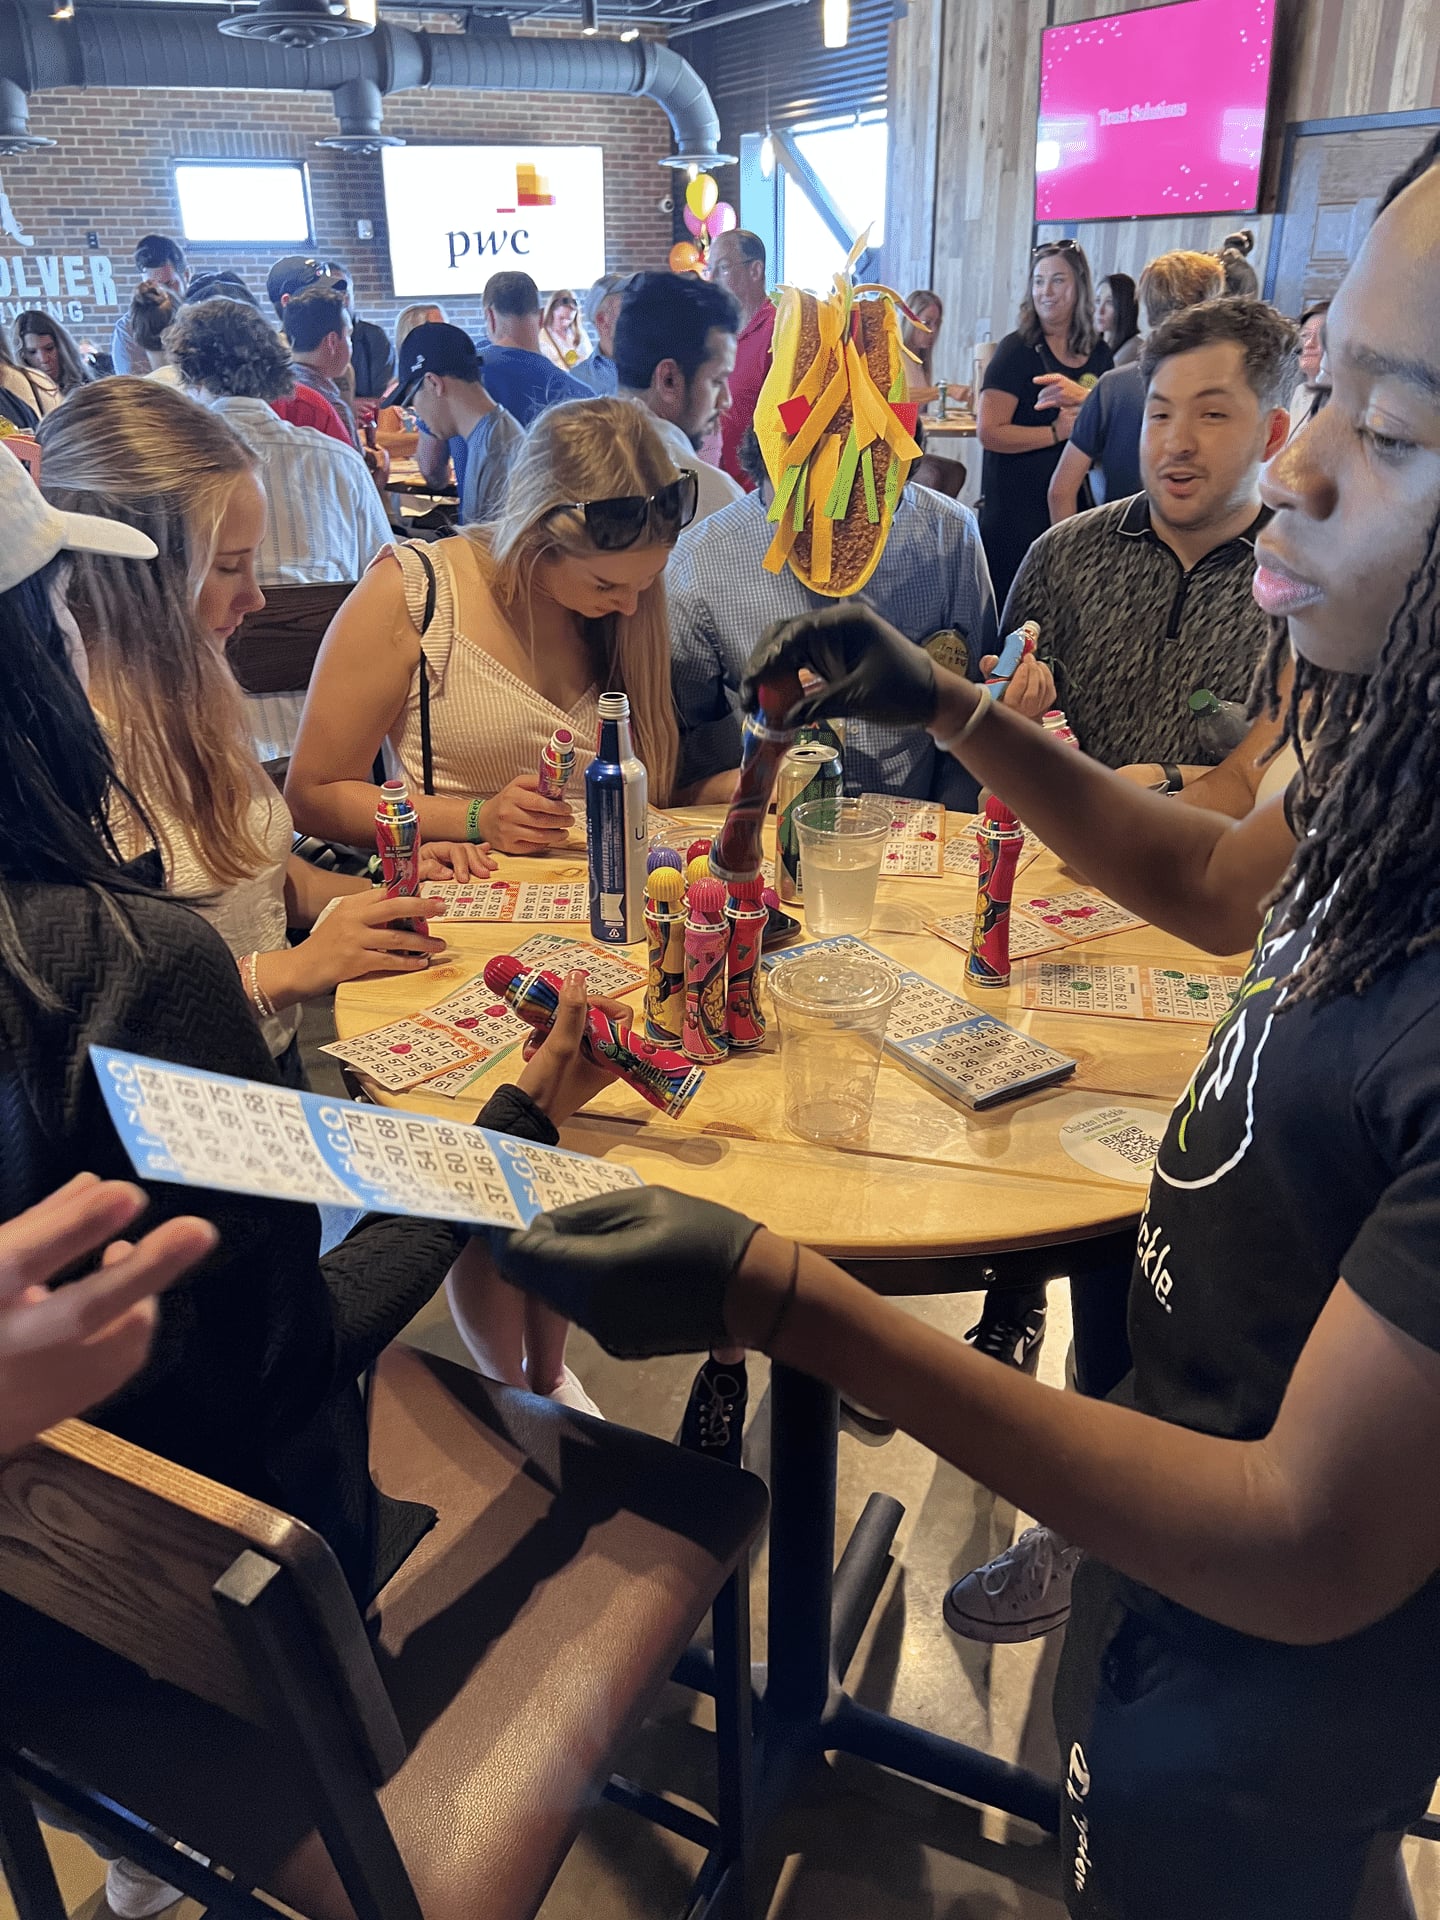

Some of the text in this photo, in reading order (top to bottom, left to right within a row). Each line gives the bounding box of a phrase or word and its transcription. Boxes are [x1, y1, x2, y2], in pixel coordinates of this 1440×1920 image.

[1130, 100, 1187, 123] Solutions
[444, 229, 530, 269] pwc
[586, 976, 616, 991] 59 71
[614, 978, 629, 986] 61
[910, 982, 926, 990] 67
[1059, 972, 1071, 980] 52
[475, 988, 487, 996] 15
[905, 989, 939, 1002] 59 68
[918, 996, 951, 1009] 49 64
[1041, 997, 1053, 1005] 12
[1060, 990, 1072, 998] 23
[1096, 992, 1108, 1000] 30
[1158, 997, 1170, 1006] 24
[1207, 975, 1227, 1011] 27 74
[1078, 1000, 1090, 1008] 13
[1176, 999, 1188, 1008] 17
[1195, 1001, 1208, 1009] 22
[432, 1007, 503, 1045] 13 19 56 65
[459, 1007, 475, 1016] 30
[487, 1021, 503, 1031] 46
[501, 1028, 518, 1039] 72
[475, 1001, 490, 1009] 17
[501, 1014, 518, 1024] 50
[515, 1021, 532, 1031] 61
[896, 1003, 963, 1027] 16 33 47 73
[906, 1026, 924, 1035] 20
[924, 1021, 942, 1030] 36
[941, 1015, 959, 1024] 50
[958, 1010, 975, 1018] 74
[381, 1027, 452, 1065] 11 20 31 54 71
[423, 1032, 439, 1041] 34
[438, 1041, 455, 1049] 47
[451, 1049, 469, 1060] 63
[932, 1034, 1019, 1065] 3 30 31 49 63
[935, 1042, 953, 1051] 18
[952, 1037, 970, 1047] 34
[969, 1032, 988, 1042] 52
[988, 1027, 1004, 1035] 61
[349, 1038, 420, 1078] 12 57 75
[366, 1033, 436, 1072] 13 51 66
[945, 1041, 1031, 1073] 9 26 53 67
[344, 1050, 361, 1058] 27
[357, 1055, 376, 1064] 37
[371, 1063, 389, 1074] 55
[385, 1073, 403, 1083] 70
[446, 1072, 465, 1081] 62
[957, 1048, 1046, 1083] 15 20 32 57 70
[974, 1056, 1060, 1091] 4 25 38 55 71
[177, 1080, 199, 1099] 61
[209, 1085, 234, 1106] 75
[435, 1080, 451, 1090] 61
[679, 1073, 697, 1099] MAGENTA
[242, 1092, 266, 1114] 68
[275, 1100, 300, 1120] 71
[345, 1113, 368, 1132] 74
[1062, 1119, 1098, 1134] Chicken
[376, 1118, 407, 1167] 50 68
[406, 1122, 437, 1172] 54 70
[435, 1126, 467, 1174] 60 66
[463, 1131, 509, 1205] 37 46 62
[534, 1166, 556, 1184] 60
